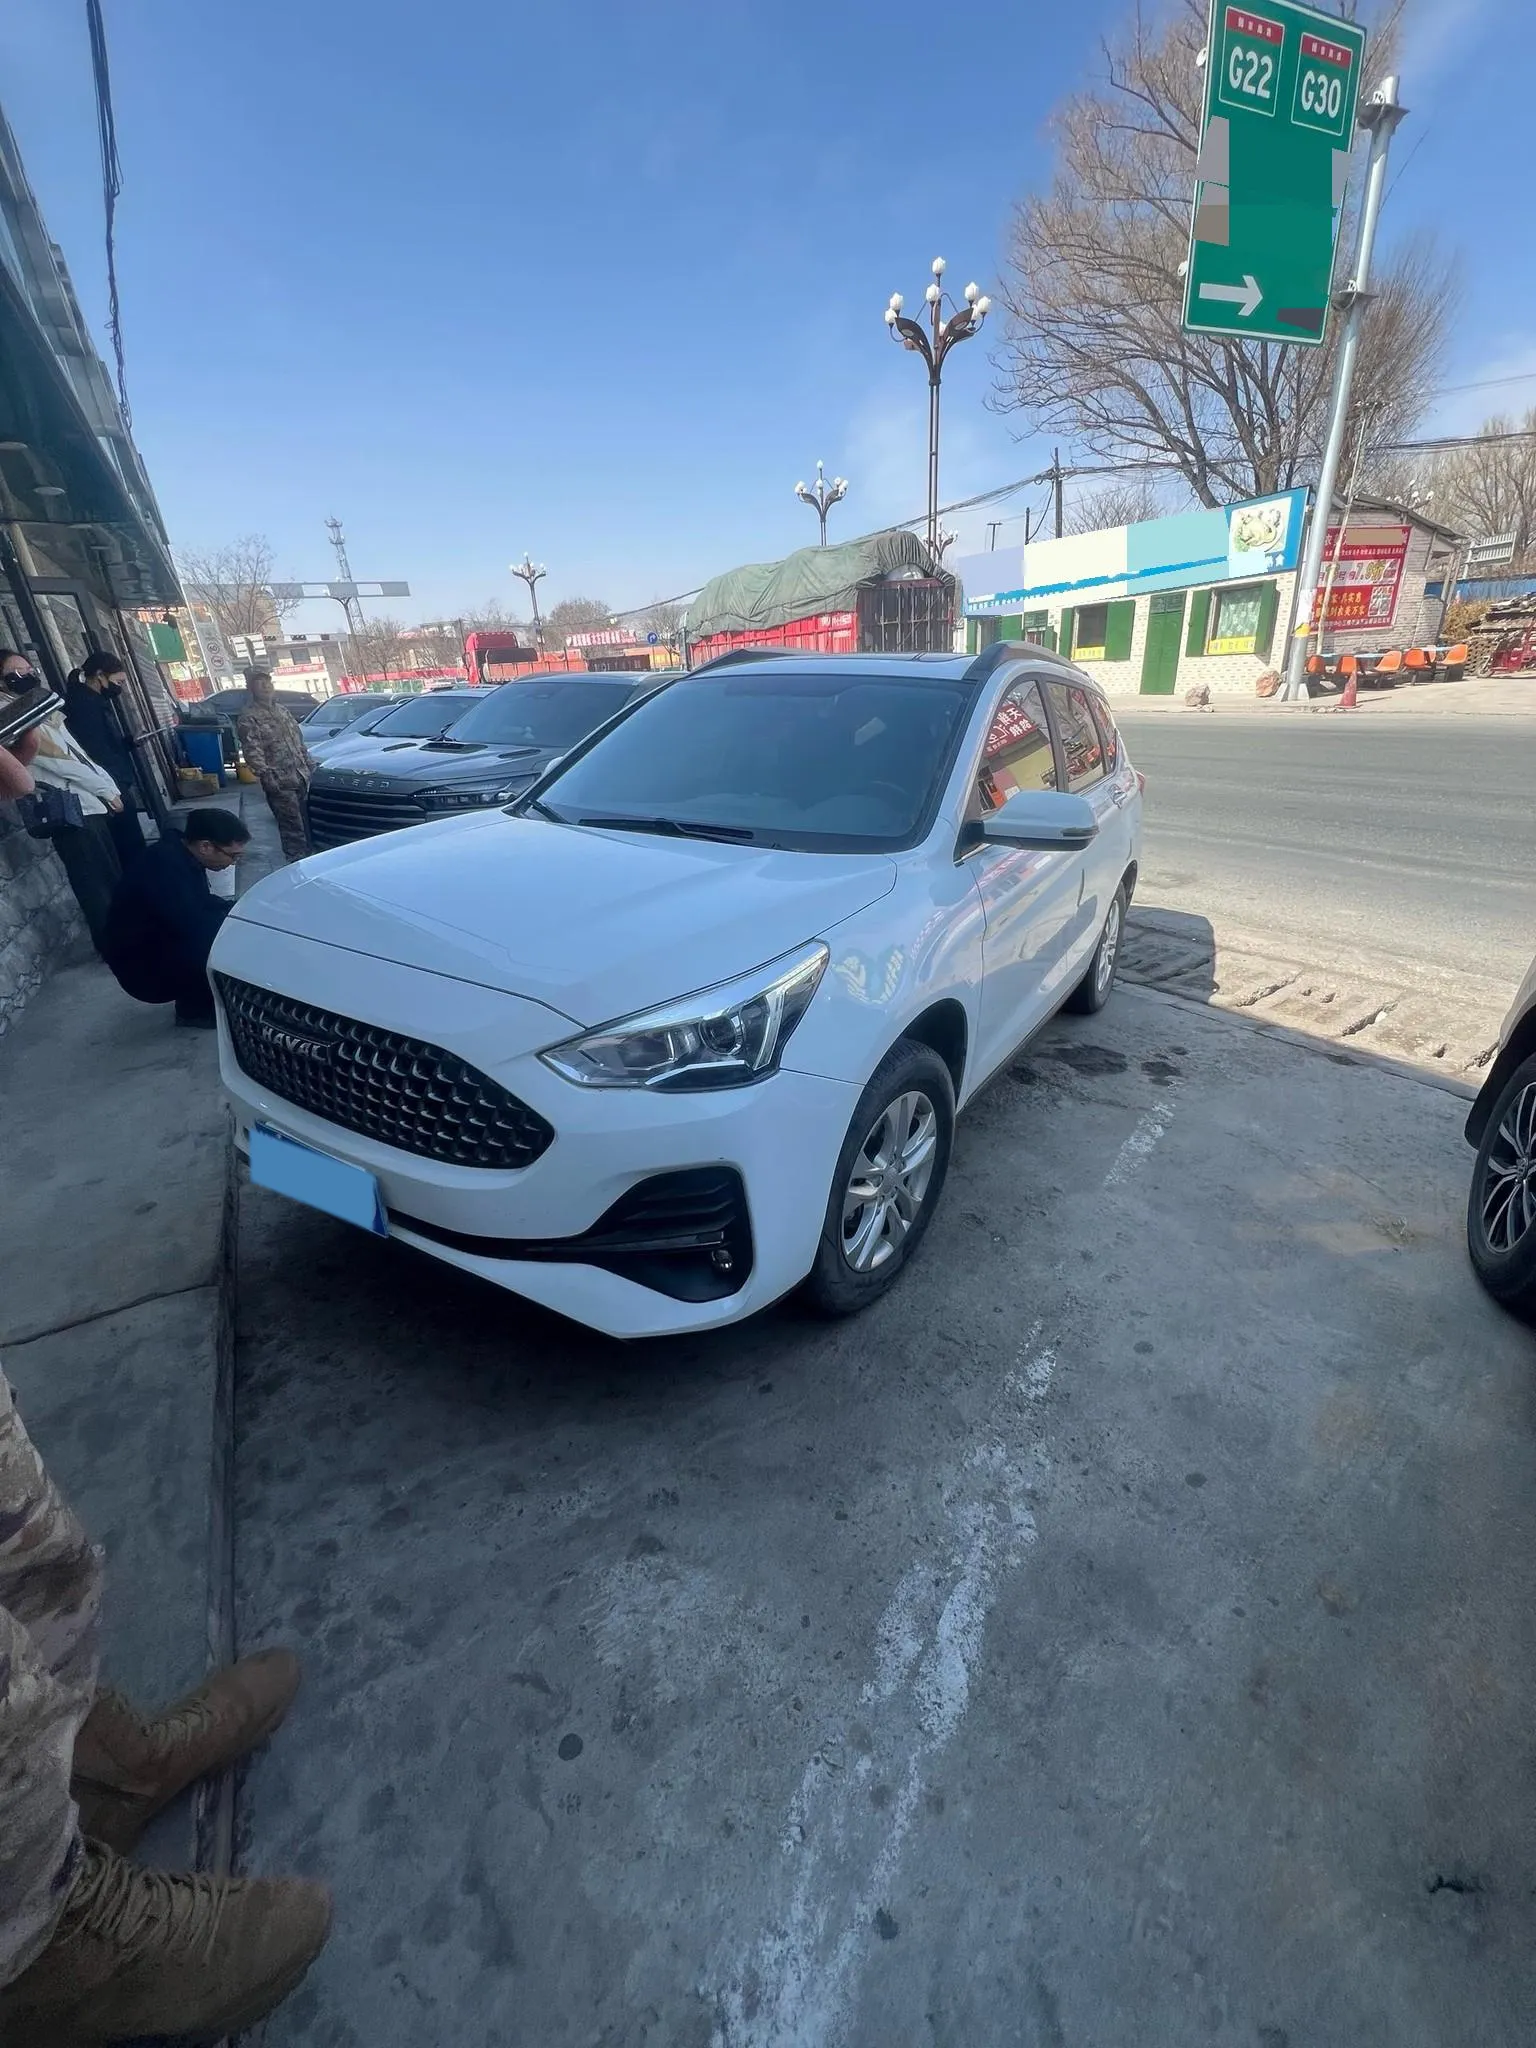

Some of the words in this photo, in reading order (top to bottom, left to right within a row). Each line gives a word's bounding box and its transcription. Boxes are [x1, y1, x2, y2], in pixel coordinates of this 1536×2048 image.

[1229, 46, 1273, 99] G22
[1301, 70, 1341, 118] G30
[262, 1026, 326, 1061] HAVAL
